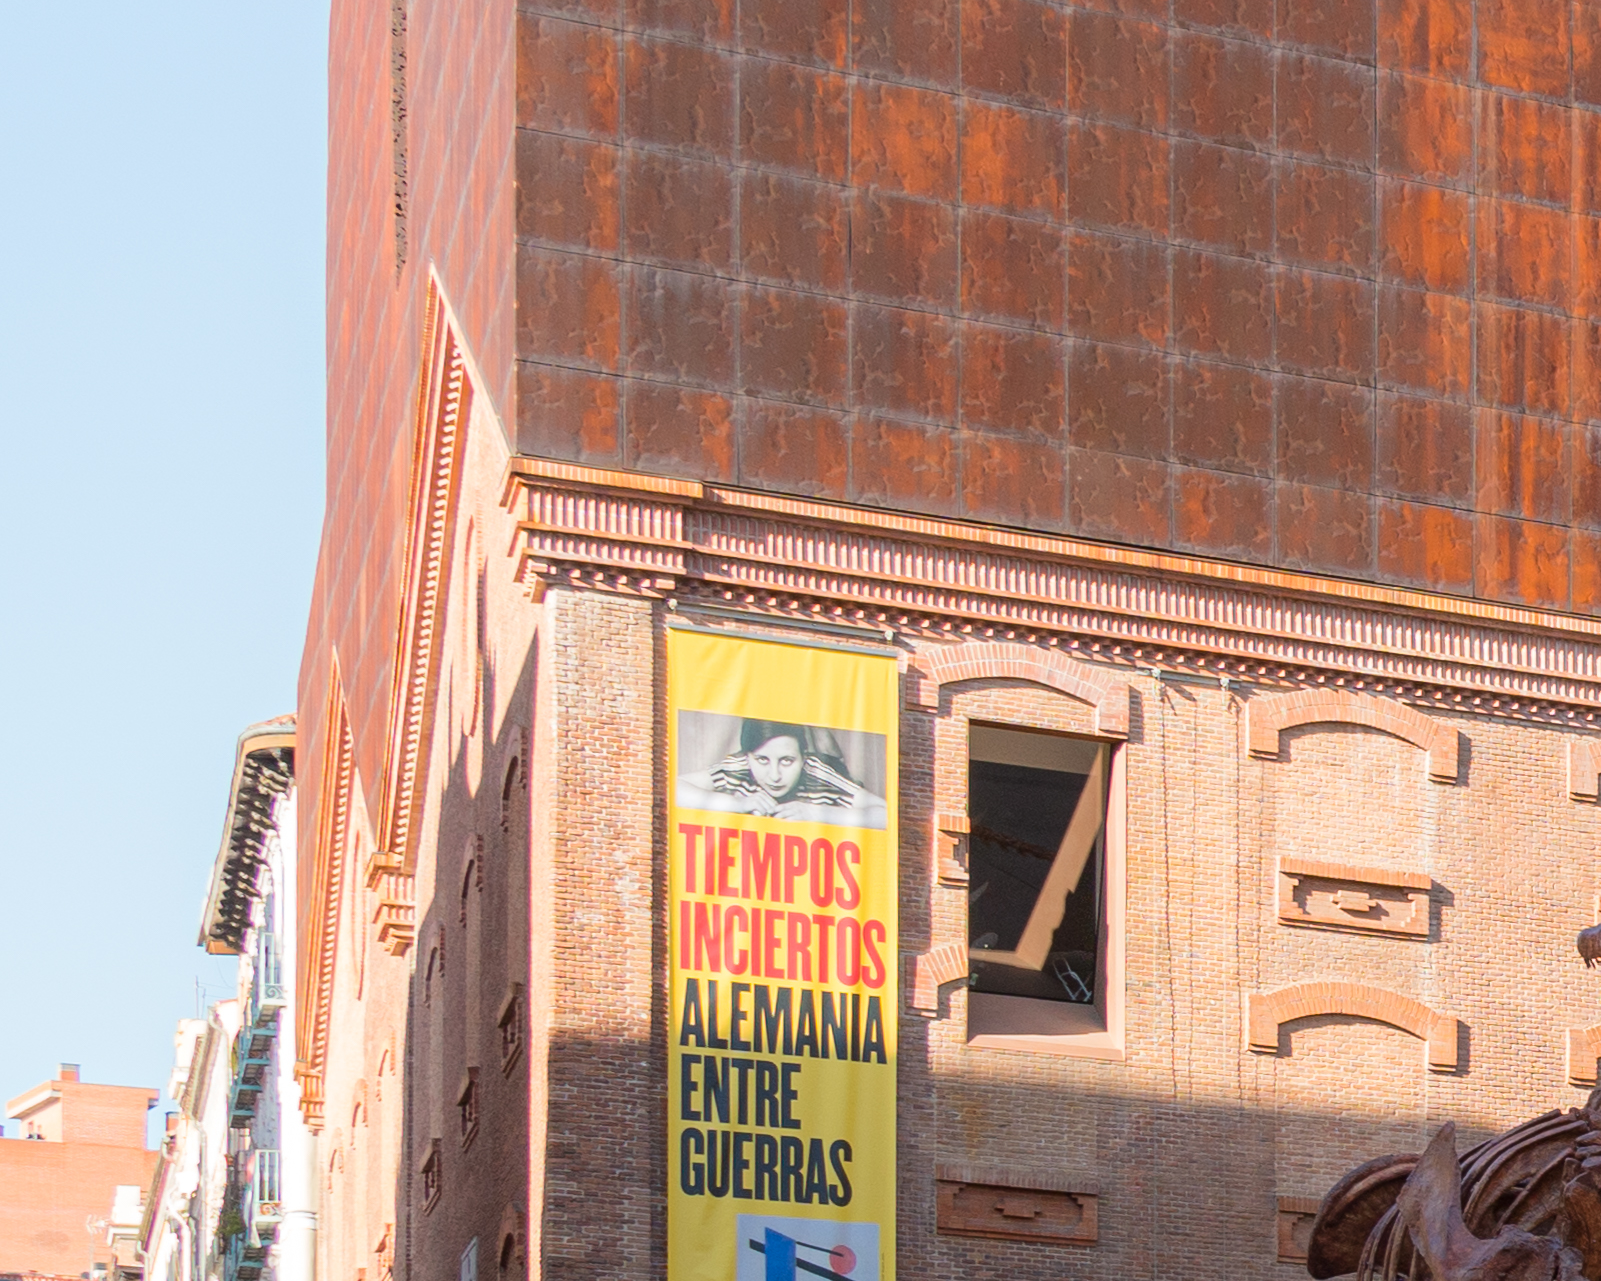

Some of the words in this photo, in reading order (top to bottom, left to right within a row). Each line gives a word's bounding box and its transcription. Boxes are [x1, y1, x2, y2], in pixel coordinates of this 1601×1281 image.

[679, 823, 861, 910] TIEMPOS
[680, 900, 886, 989] INCIERTOS
[680, 978, 887, 1064] ALEMANIA
[681, 1053, 801, 1129] ENTRE
[680, 1127, 853, 1207] GUERRAS
